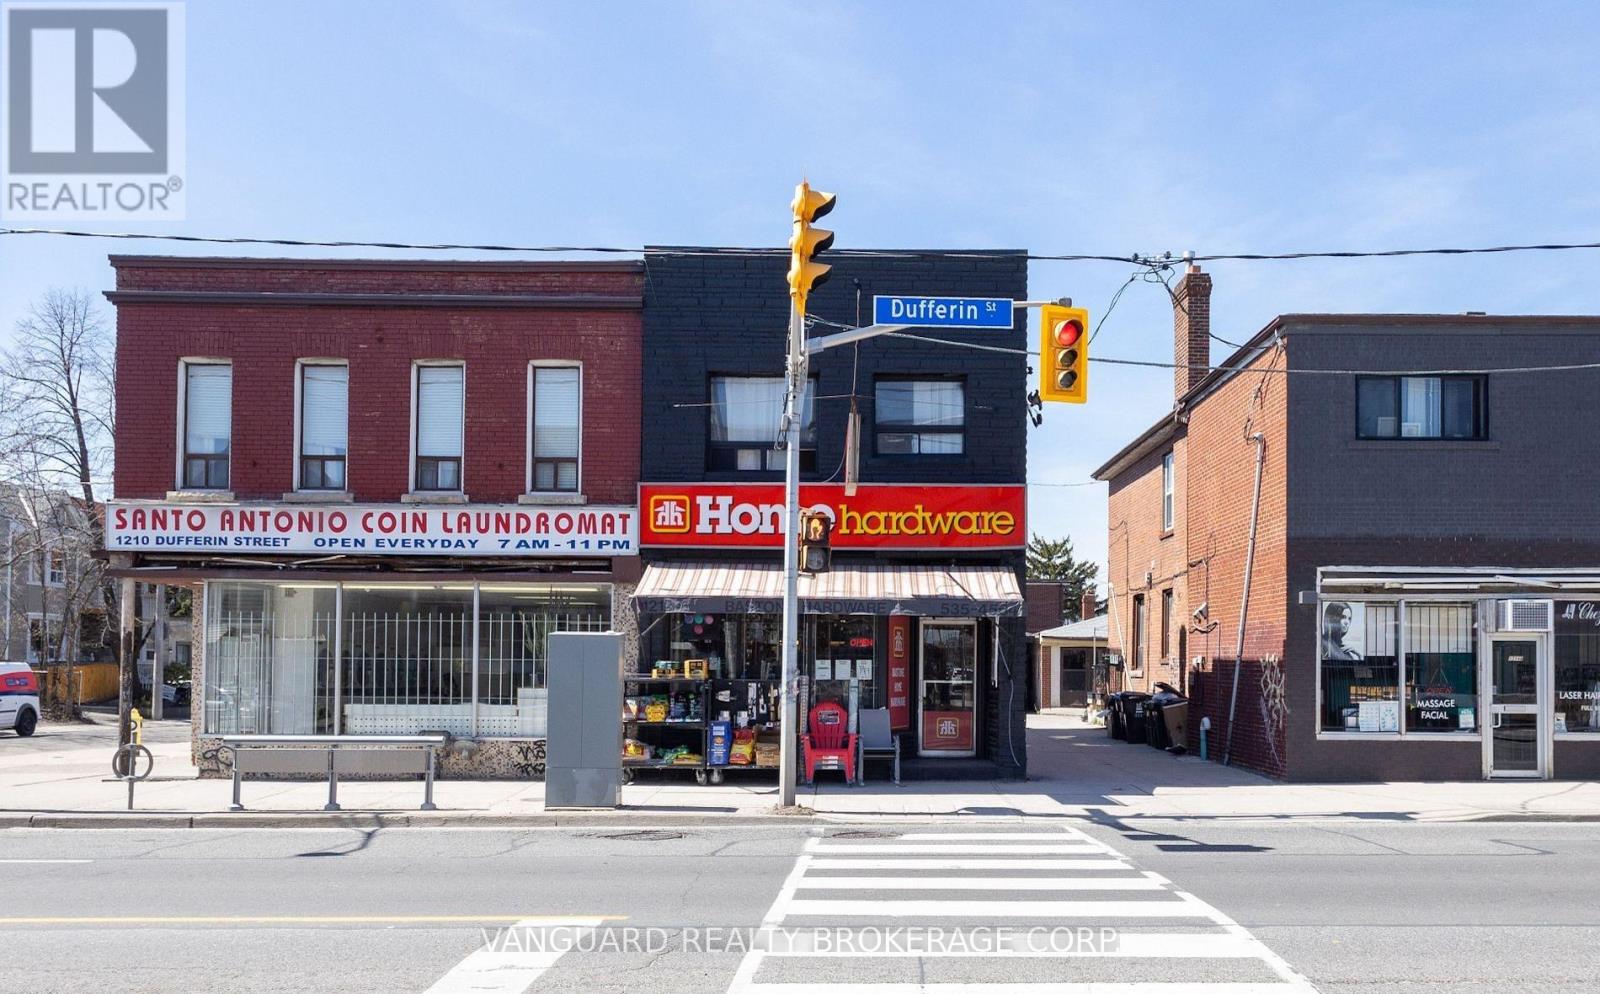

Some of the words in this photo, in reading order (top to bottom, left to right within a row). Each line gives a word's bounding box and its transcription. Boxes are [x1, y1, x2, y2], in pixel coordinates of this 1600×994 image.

[891, 299, 978, 320] Dufferin
[115, 508, 206, 532] SANTO
[220, 511, 348, 533] ANTONIO
[362, 512, 427, 534] COIN
[442, 512, 631, 535] LAUNDROMAT
[839, 504, 1015, 536] hardware
[116, 535, 150, 546] 1210
[155, 536, 228, 546] DUFFERIN
[234, 537, 290, 547] STREET
[314, 538, 365, 548] OPEN
[375, 538, 479, 549] EVERYDAY
[1560, 691, 1582, 699] LASER
[1416, 699, 1456, 708] MASSAGE
[1421, 711, 1449, 719] FACIAL
